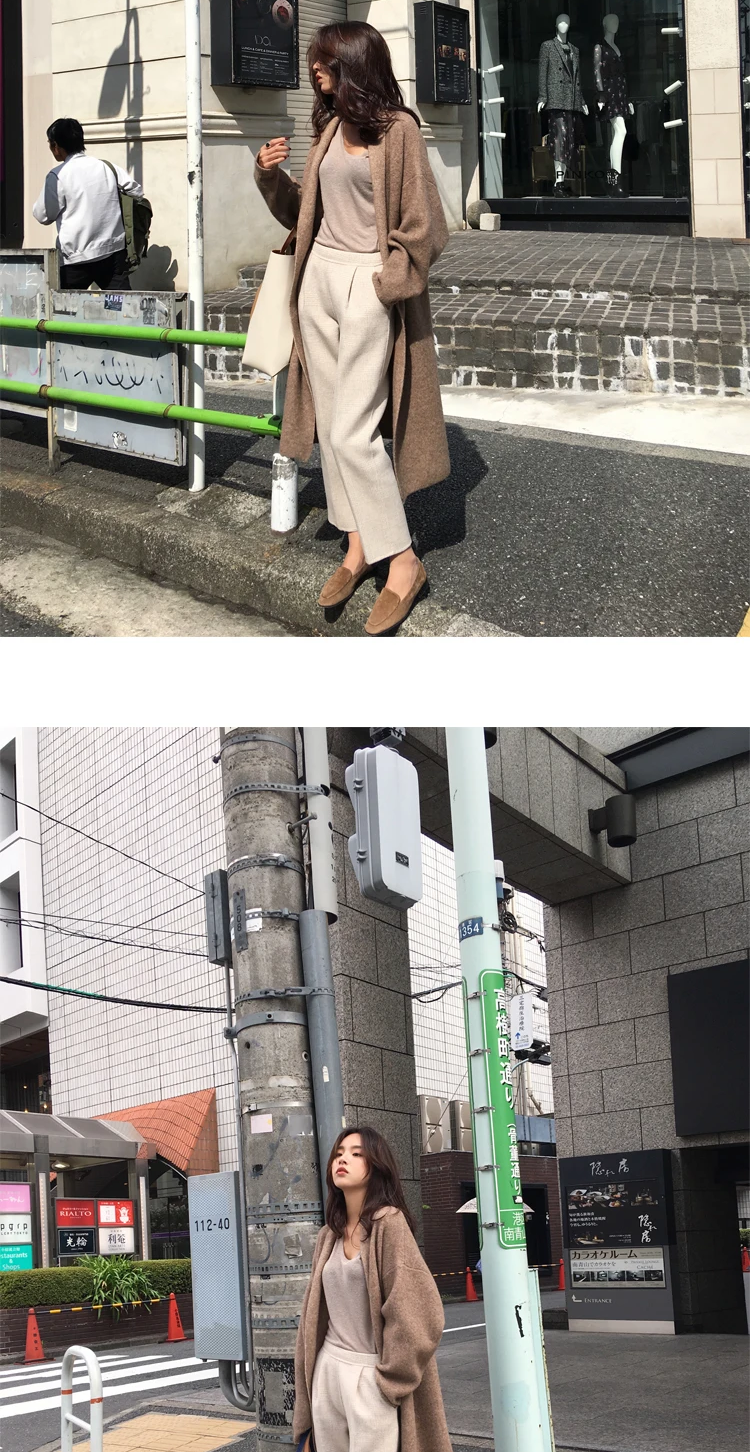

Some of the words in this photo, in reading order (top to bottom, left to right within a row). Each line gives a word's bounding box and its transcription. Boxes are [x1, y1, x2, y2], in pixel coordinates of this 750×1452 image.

[556, 170, 605, 179] PINKO
[194, 1217, 231, 1232] 112-40
[572, 1249, 638, 1260] カラオケルーム
